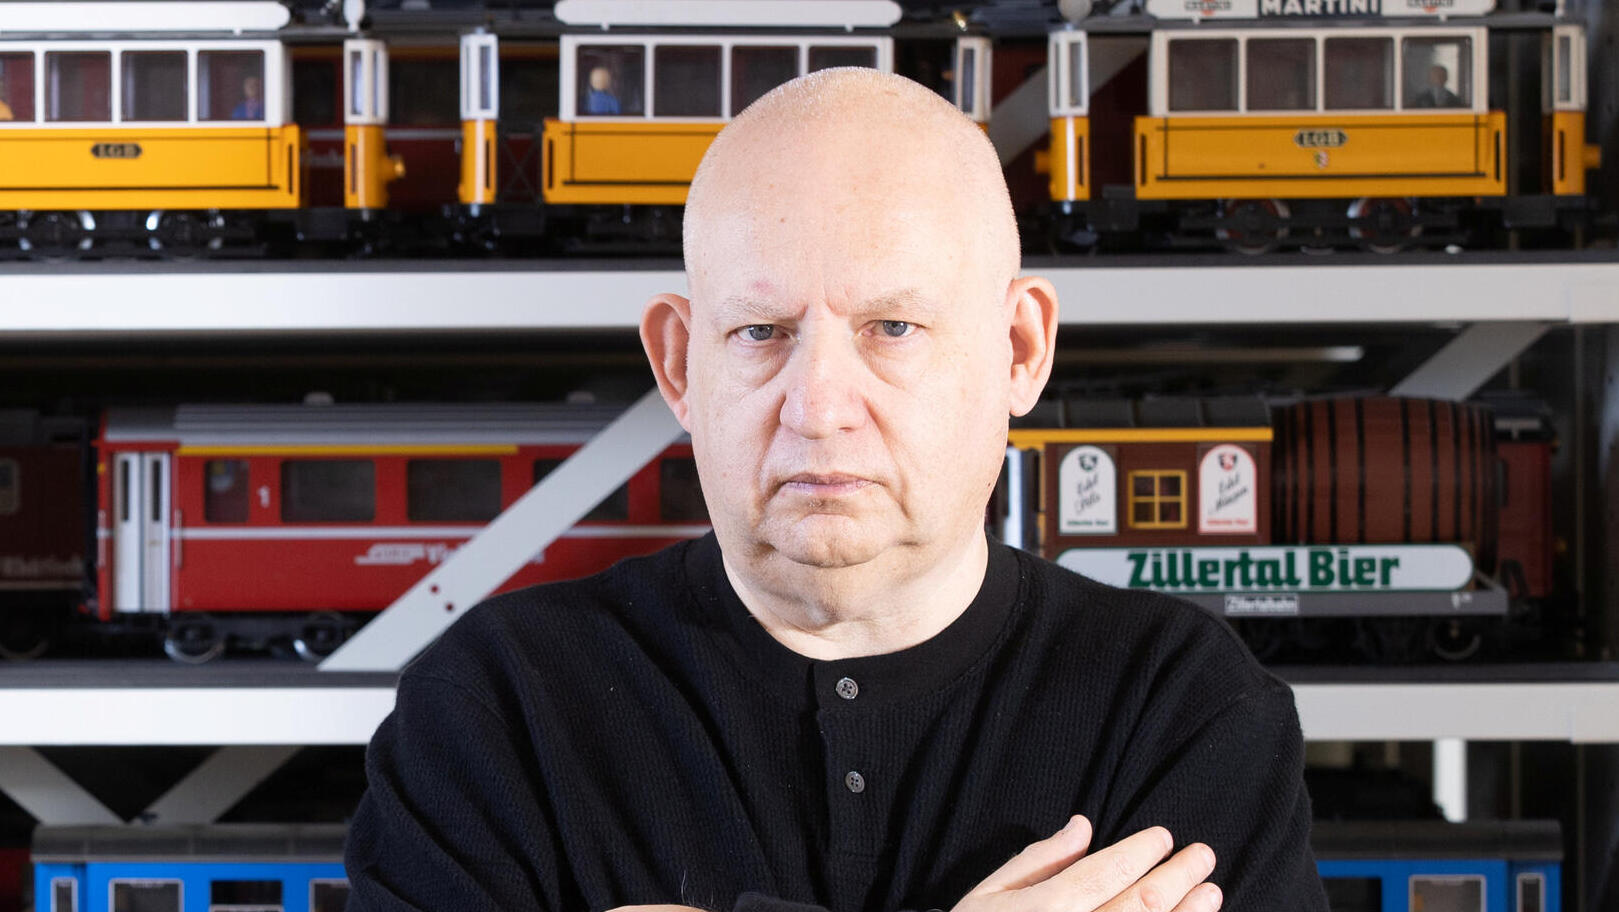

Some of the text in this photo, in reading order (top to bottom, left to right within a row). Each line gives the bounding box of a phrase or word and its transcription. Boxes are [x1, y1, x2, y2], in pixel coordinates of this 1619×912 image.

[1261, 0, 1379, 16] MARTINI
[1127, 550, 1399, 588] Zillertal Bier
